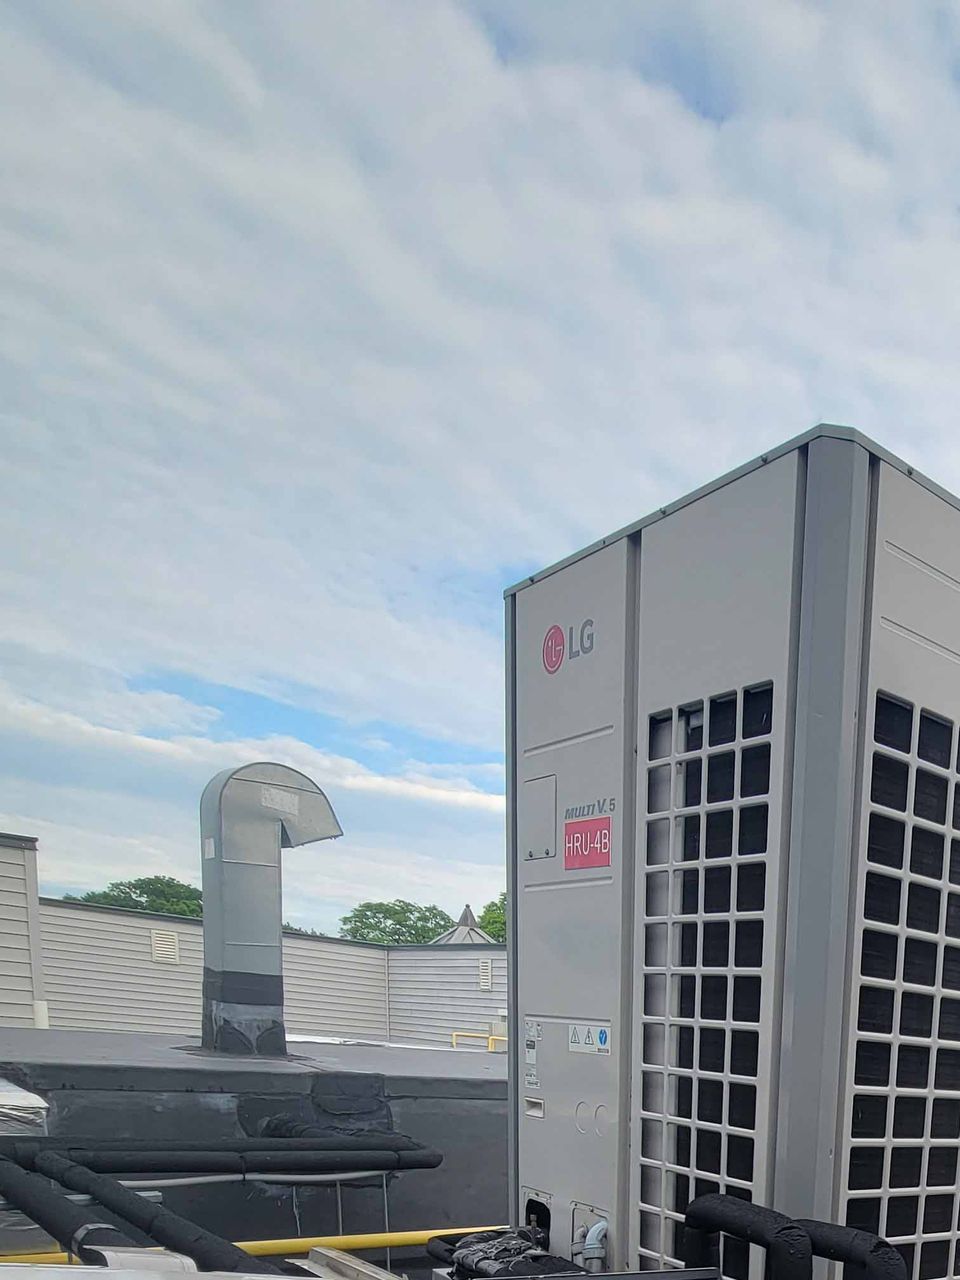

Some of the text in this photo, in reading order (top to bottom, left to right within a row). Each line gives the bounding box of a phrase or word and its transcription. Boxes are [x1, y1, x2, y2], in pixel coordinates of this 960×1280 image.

[568, 618, 595, 660] LG
[564, 803, 596, 819] MULTI
[565, 830, 610, 857] HRU-4B
